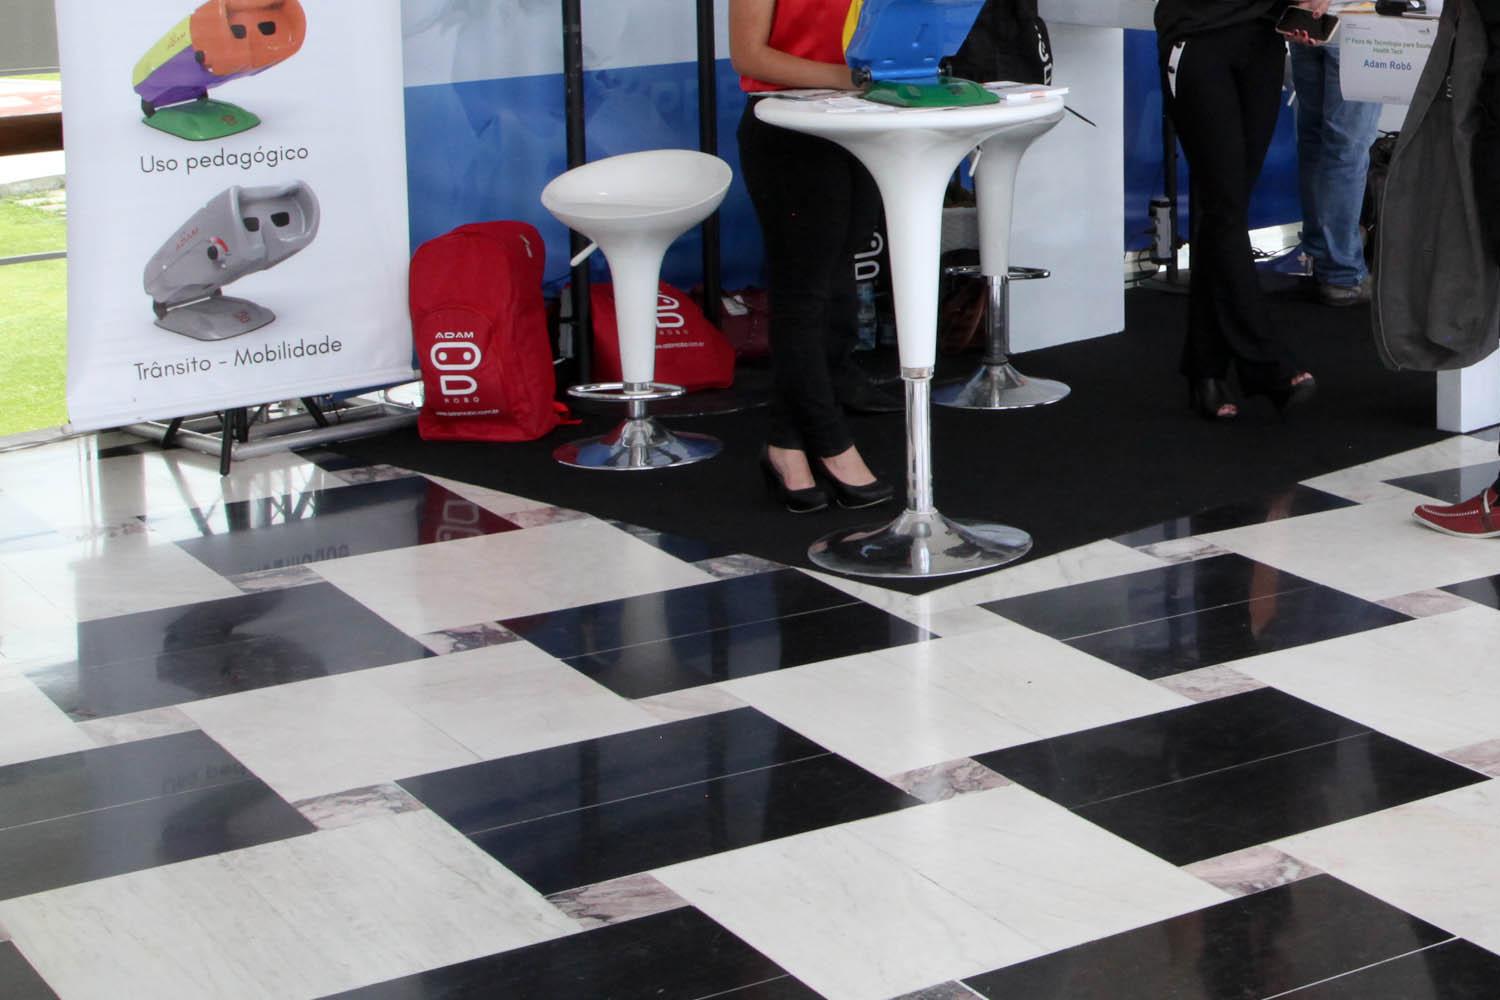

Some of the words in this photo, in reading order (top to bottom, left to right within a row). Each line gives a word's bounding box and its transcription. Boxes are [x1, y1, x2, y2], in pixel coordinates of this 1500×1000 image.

[1363, 58, 1387, 69] Adam
[140, 155, 178, 174] Uso
[186, 144, 309, 176] pedagógico
[435, 331, 475, 339] ADAM
[134, 354, 213, 382] Trânsito
[233, 336, 343, 367] Mobilidade
